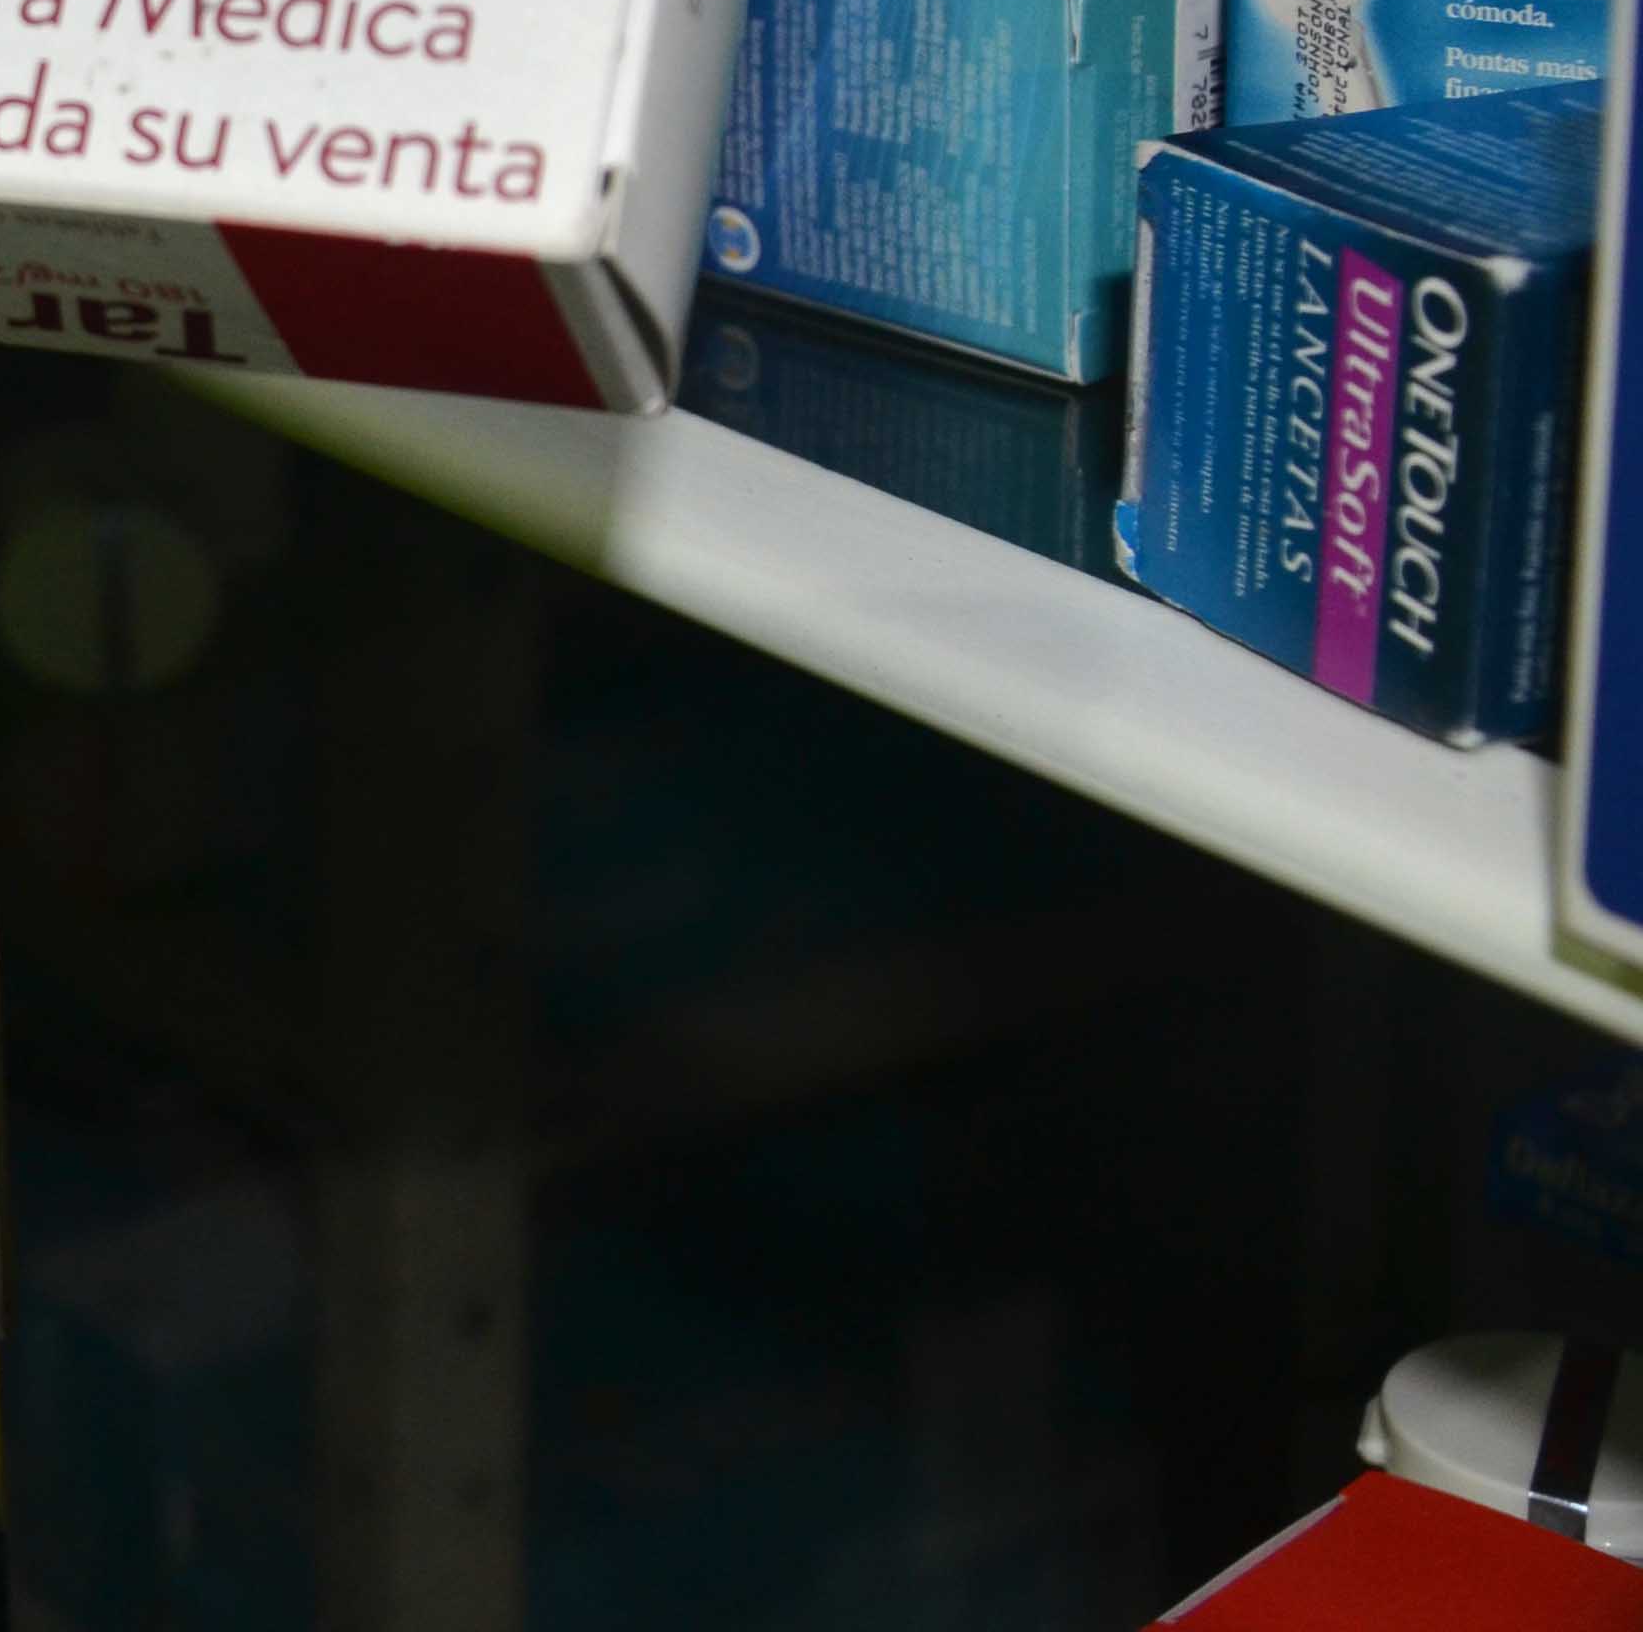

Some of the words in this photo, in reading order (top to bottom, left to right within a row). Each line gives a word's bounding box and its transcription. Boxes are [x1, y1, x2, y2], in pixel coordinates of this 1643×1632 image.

[1446, 0, 1555, 28] cómoda.
[1191, 75, 1208, 130] 702
[1445, 46, 1530, 74] Pontas
[1535, 59, 1598, 81] mais
[123, 101, 230, 172] su
[262, 117, 550, 204] venta
[1279, 235, 1333, 584] LANCETAS
[1328, 274, 1395, 601] UltraSoft
